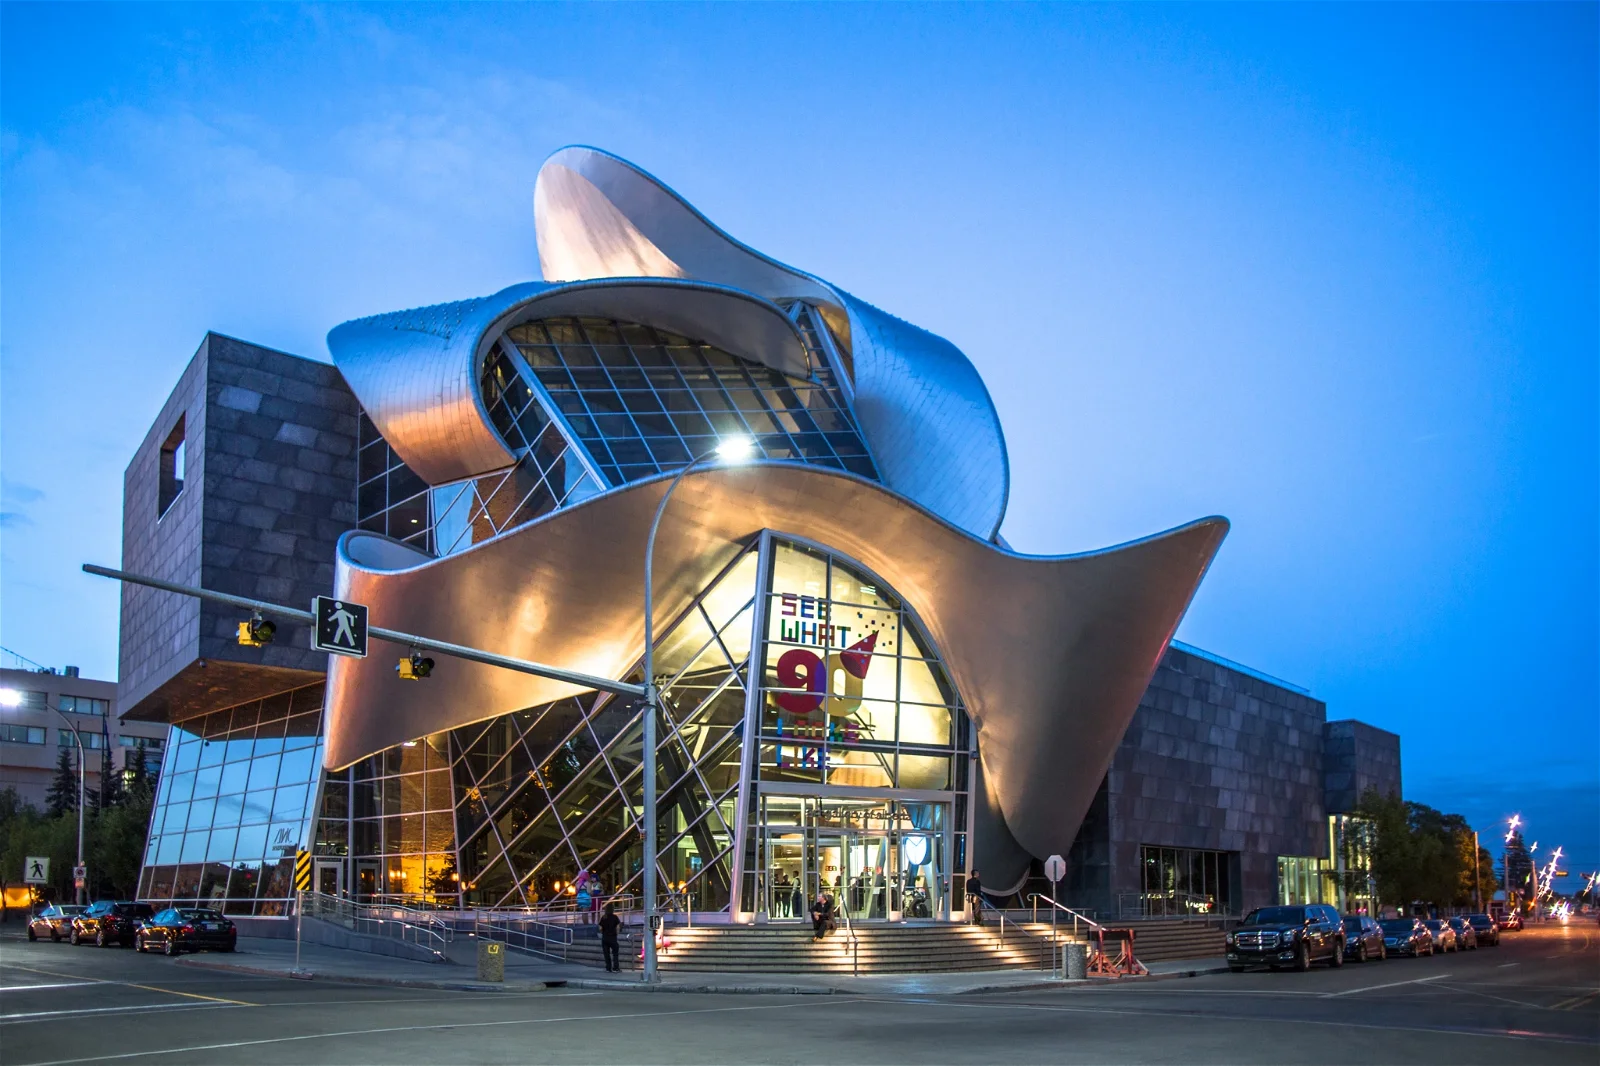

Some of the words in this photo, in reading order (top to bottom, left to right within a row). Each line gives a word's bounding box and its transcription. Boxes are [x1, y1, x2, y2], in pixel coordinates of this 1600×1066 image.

[781, 592, 832, 621] SEE
[781, 619, 852, 648] WHAT
[776, 649, 863, 717] 90
[777, 718, 860, 744] LOOKS
[776, 744, 831, 770] LIKE
